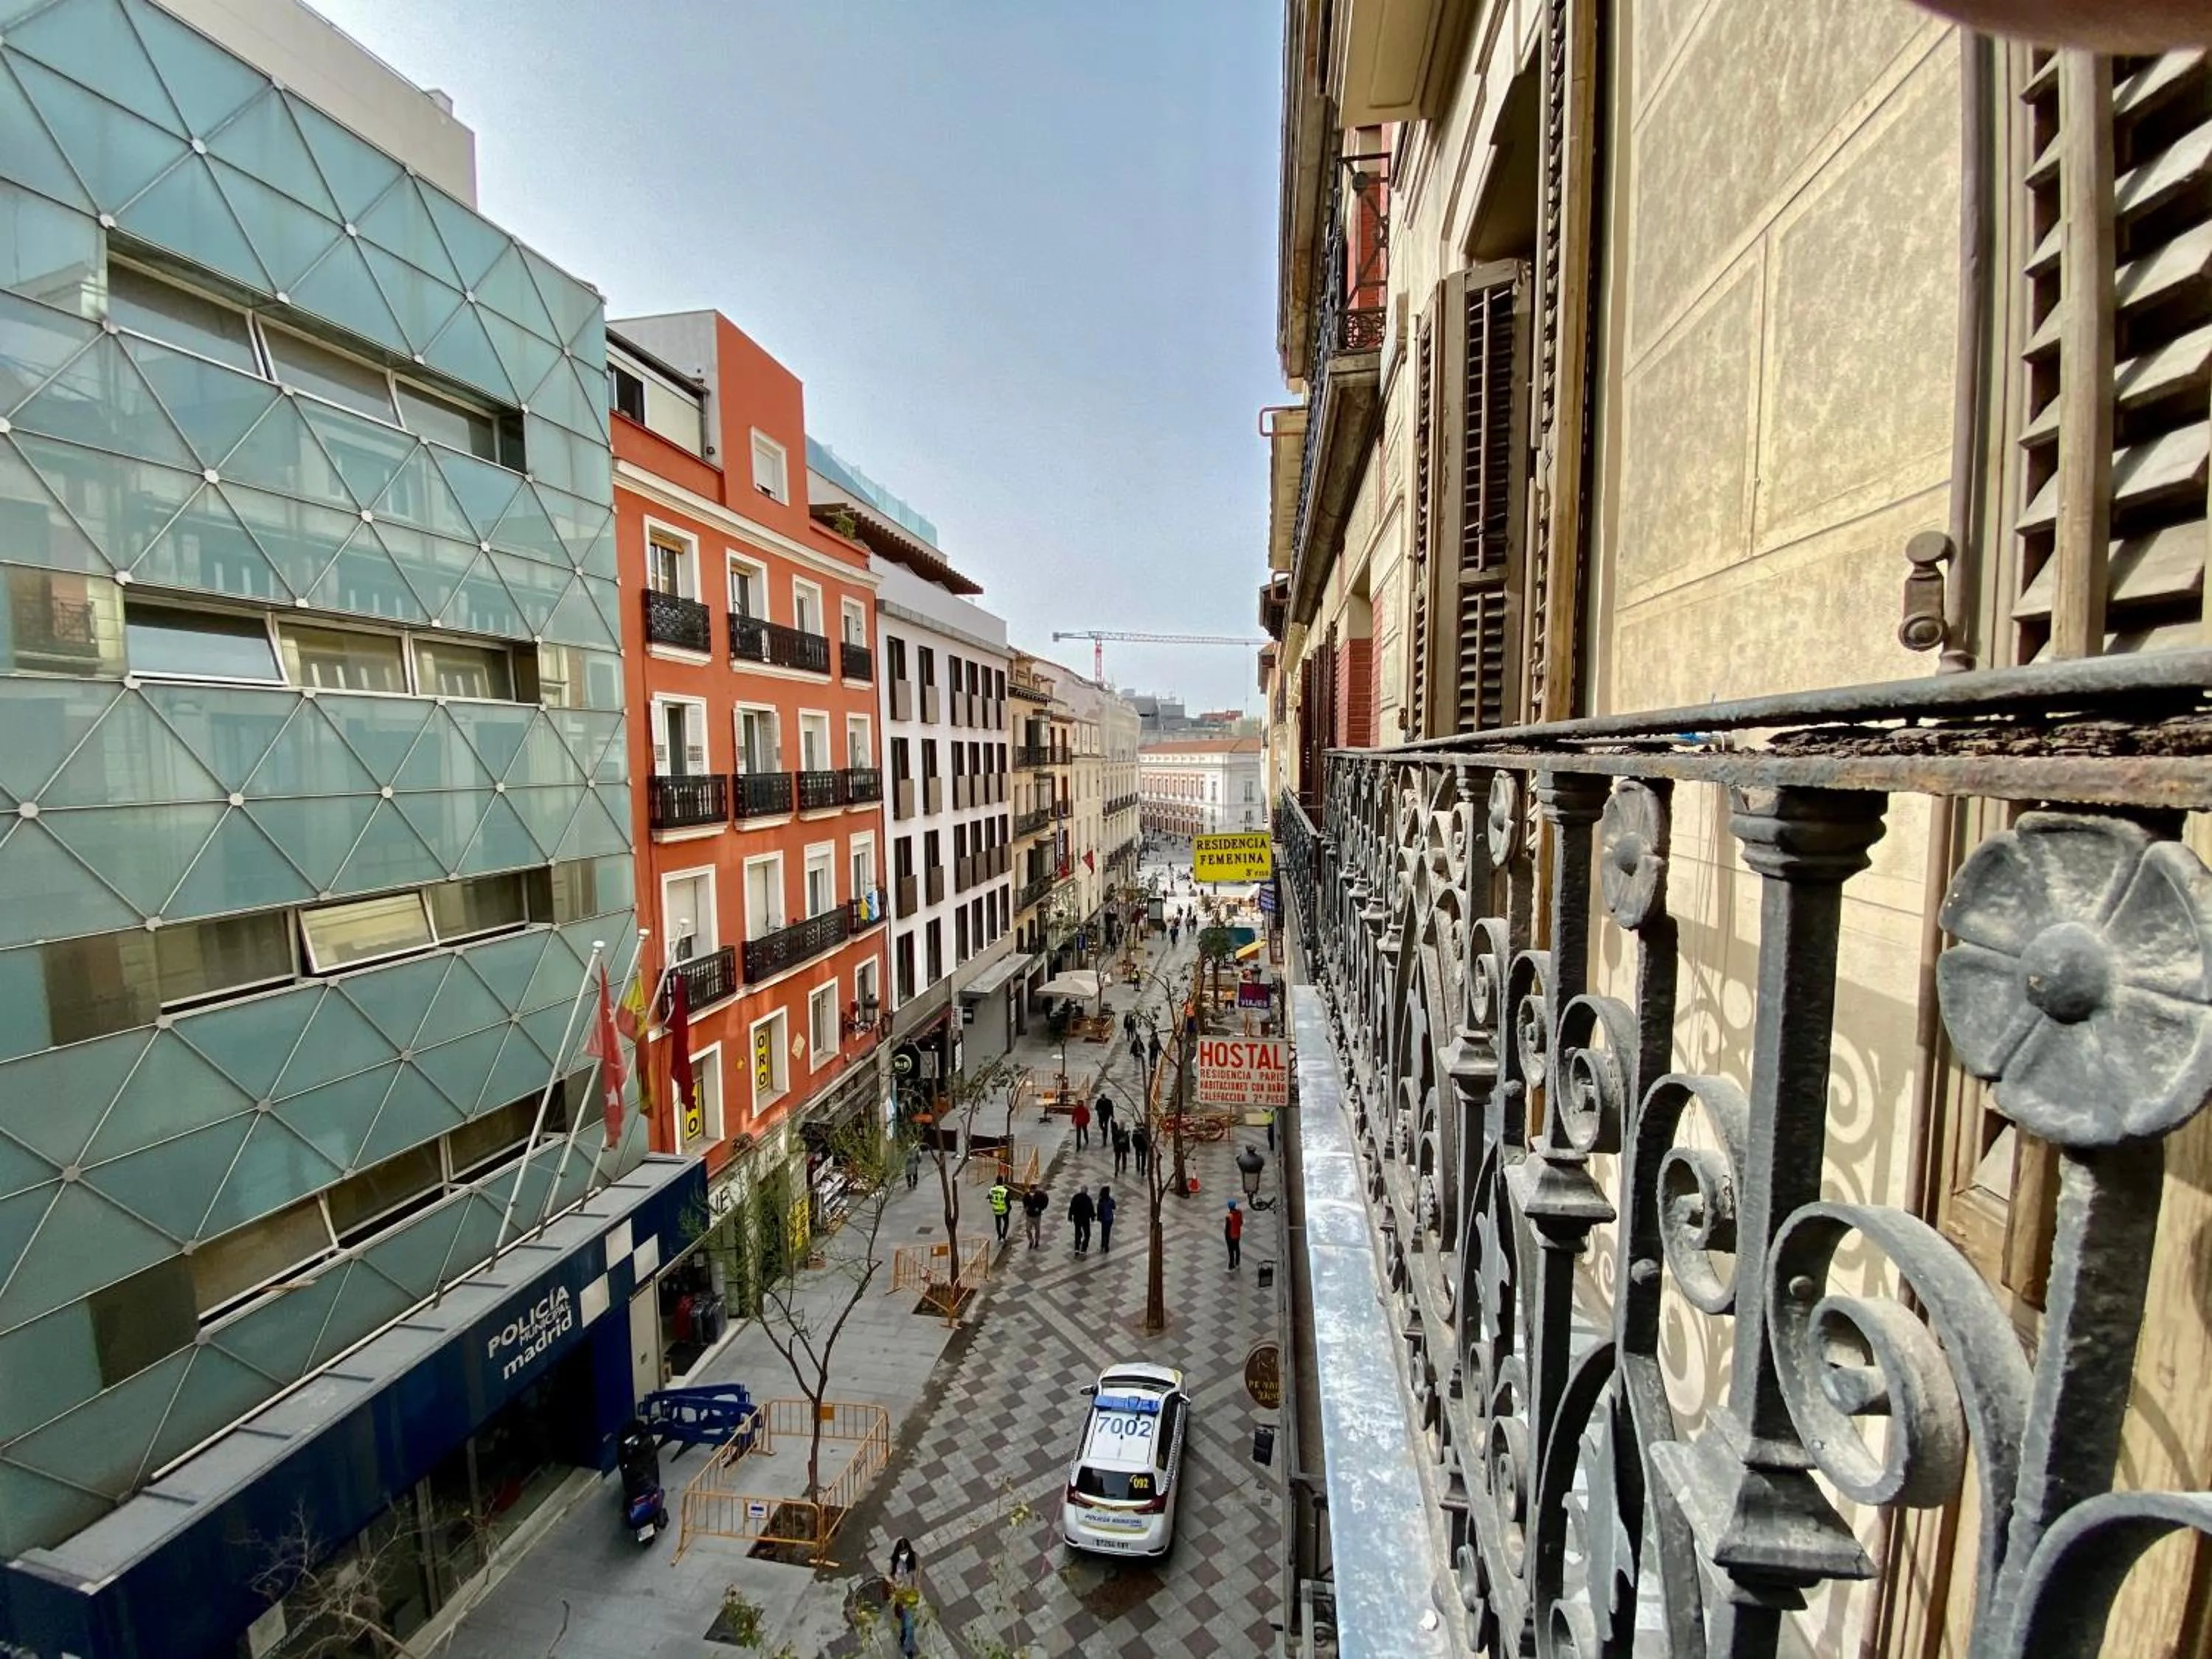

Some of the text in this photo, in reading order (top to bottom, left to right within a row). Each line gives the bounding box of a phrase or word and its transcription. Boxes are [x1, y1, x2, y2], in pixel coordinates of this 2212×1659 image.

[1197, 838, 1267, 850] RESIDENCIA
[1200, 853, 1265, 866] FEMENINA
[1240, 998, 1267, 1008] VIAJES
[757, 1034, 767, 1086] ORO
[1200, 1040, 1286, 1071] HOSTAL
[1200, 1069, 1286, 1082] RESIDENCIA PARIS
[1200, 1080, 1248, 1091] HABITACIONES
[1252, 1082, 1264, 1091] CON
[1266, 1094, 1285, 1104] PISO
[503, 1310, 572, 1380] madrid
[1098, 1416, 1152, 1438] 7002
[1133, 1478, 1150, 1489] 092
